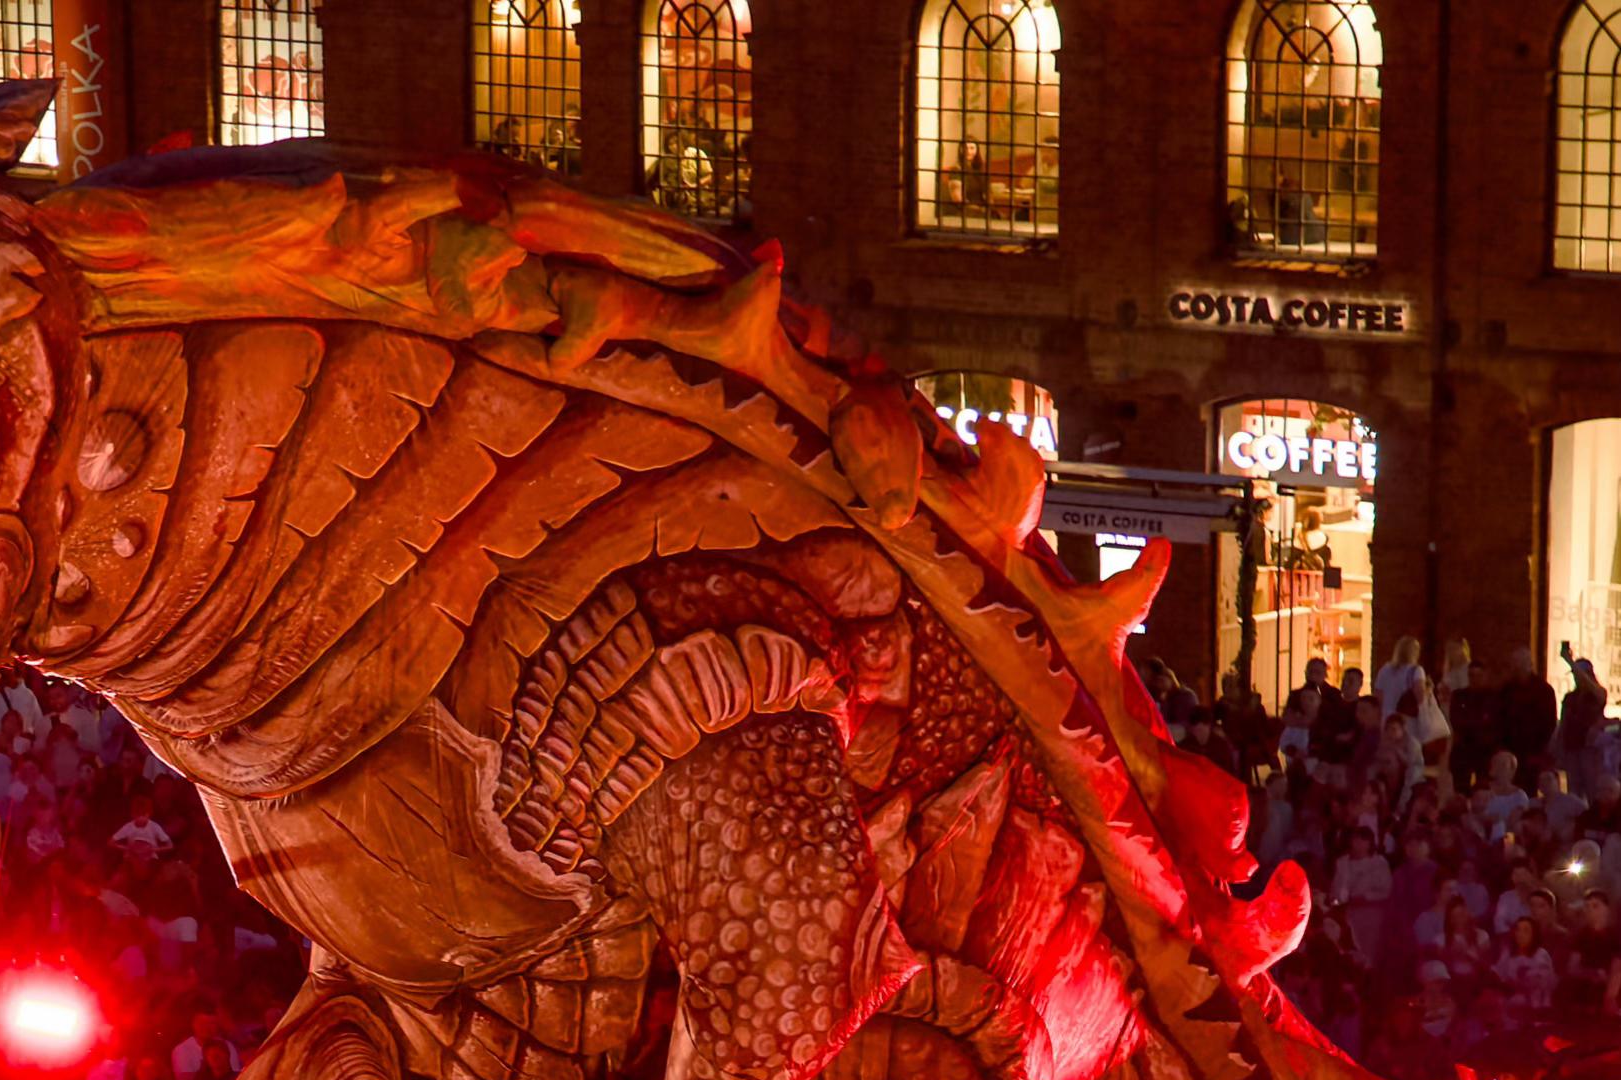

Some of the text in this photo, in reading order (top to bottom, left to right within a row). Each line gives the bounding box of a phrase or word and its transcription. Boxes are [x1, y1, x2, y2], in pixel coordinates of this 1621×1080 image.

[1168, 291, 1404, 333] COSTA COFFEE
[935, 406, 1057, 452] OTA
[1228, 431, 1376, 480] COFFEE
[1062, 511, 1164, 533] COSTA COFFEE
